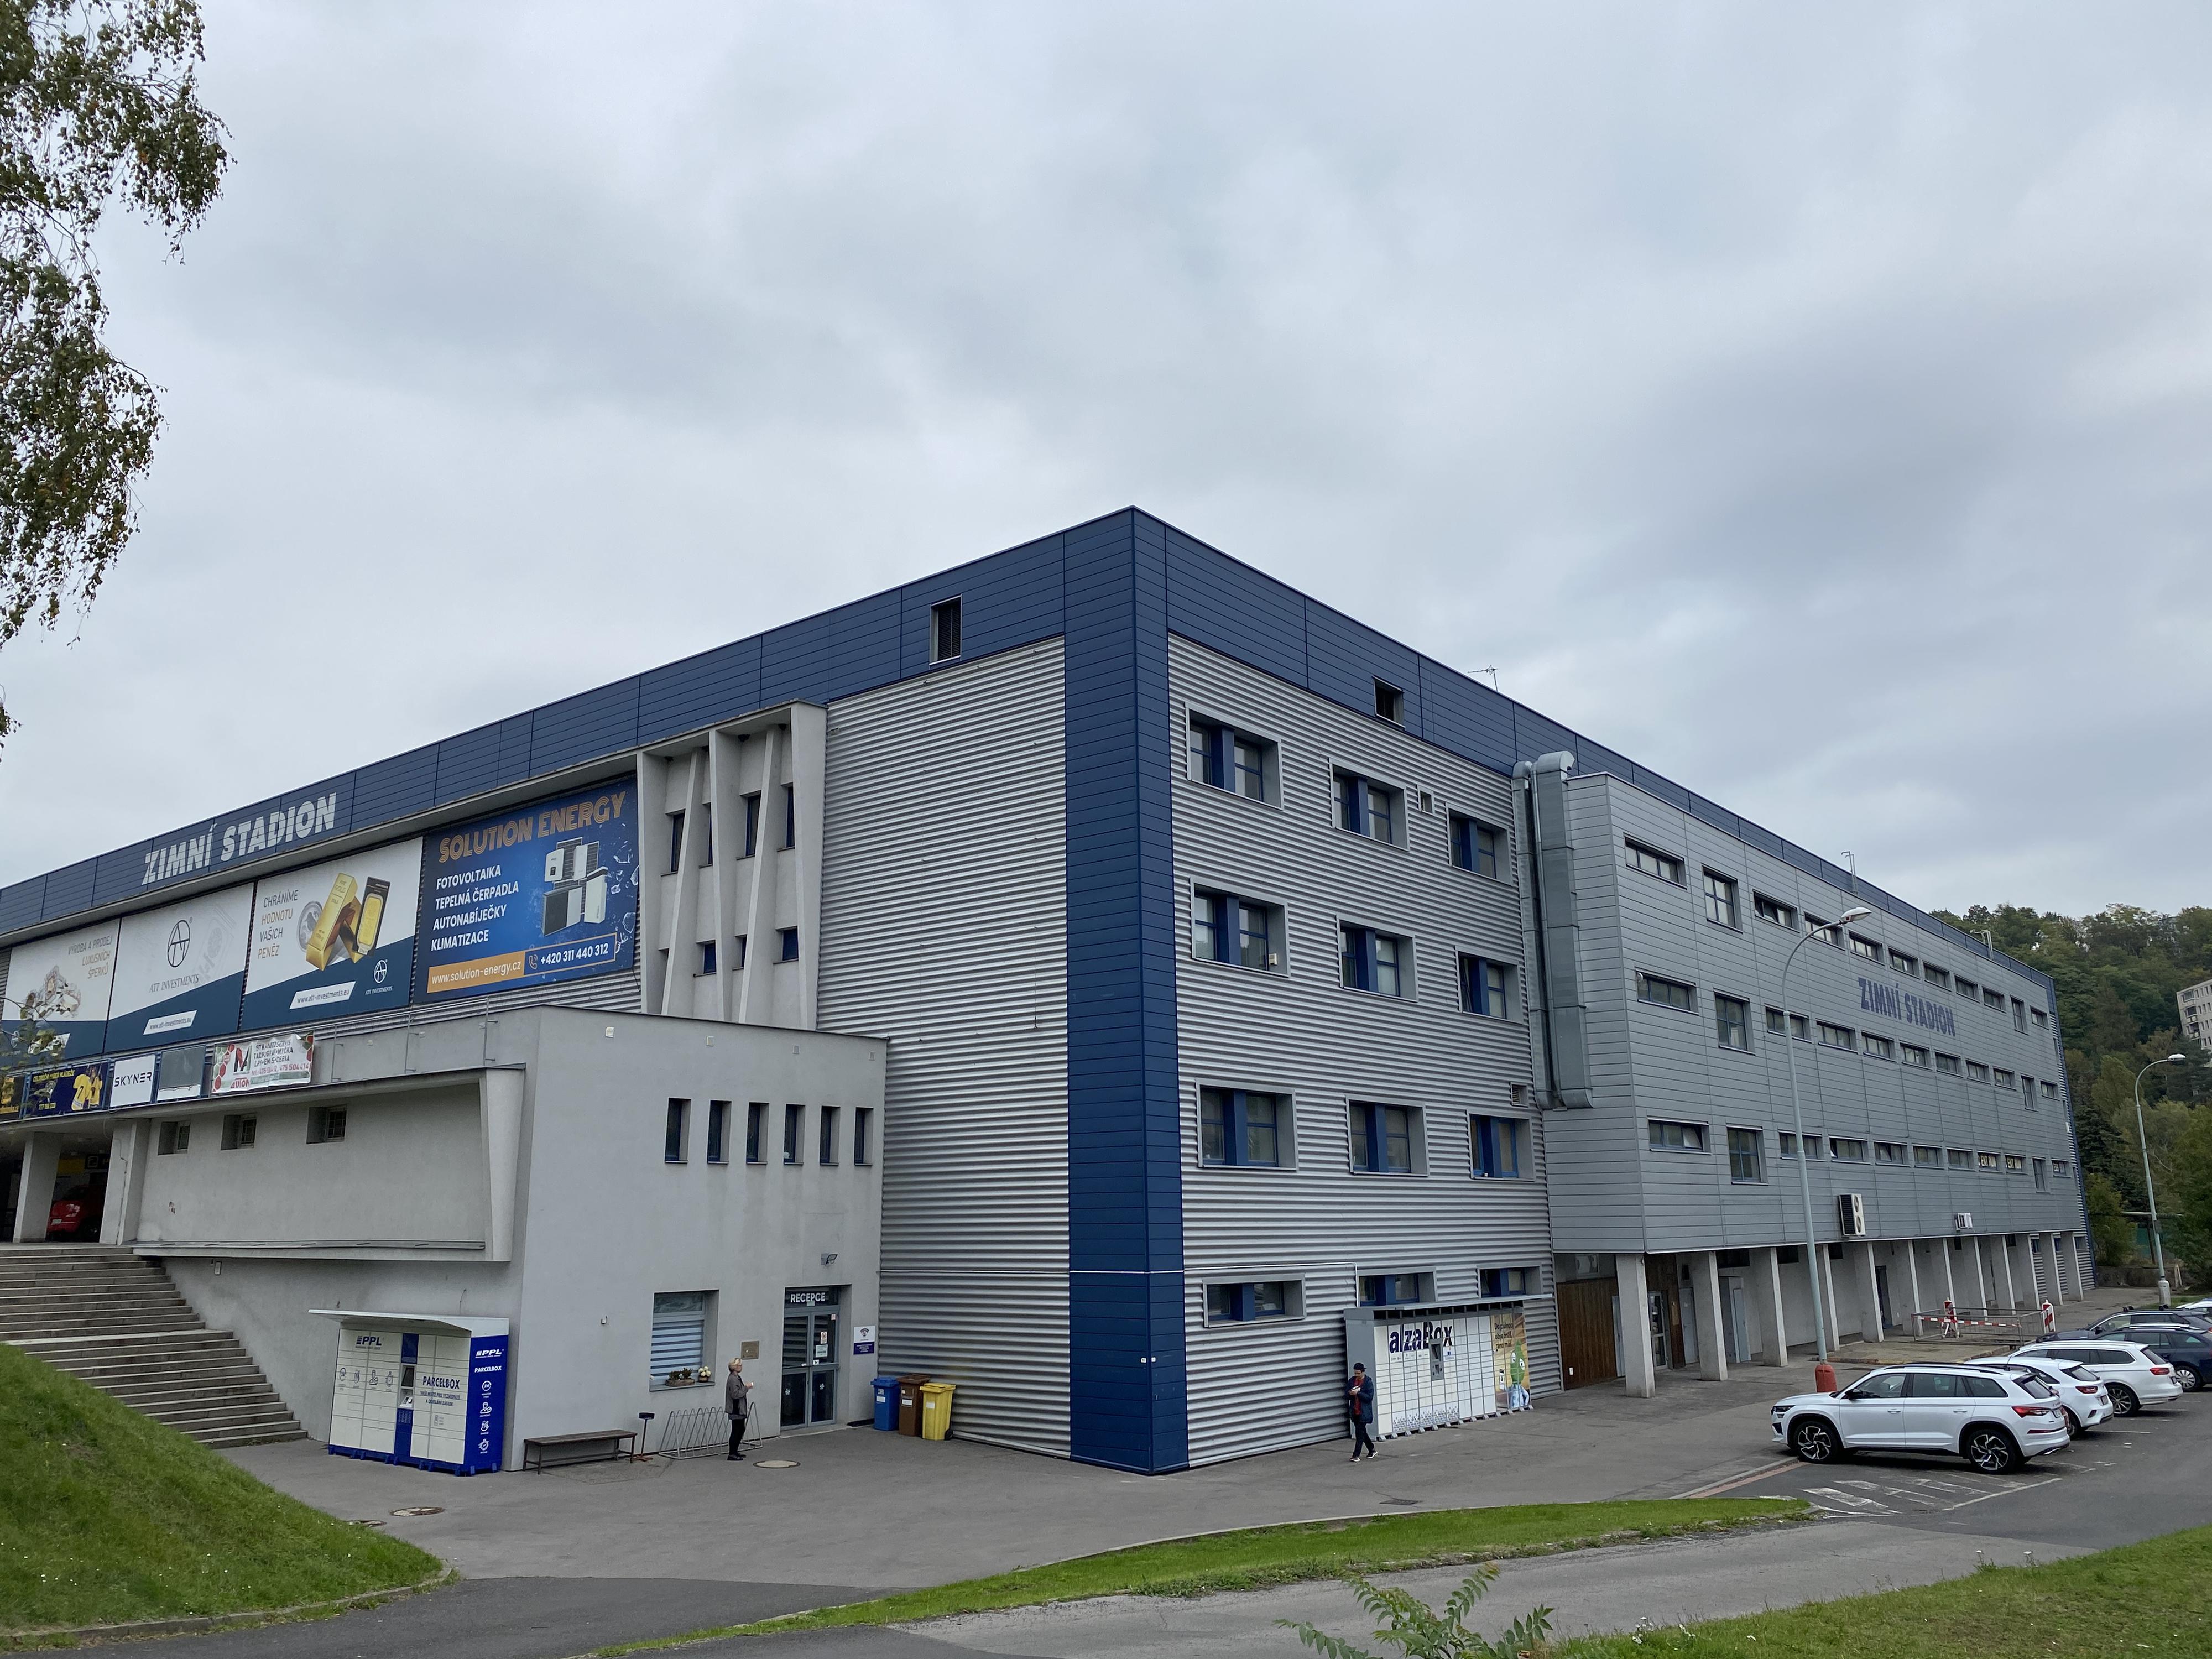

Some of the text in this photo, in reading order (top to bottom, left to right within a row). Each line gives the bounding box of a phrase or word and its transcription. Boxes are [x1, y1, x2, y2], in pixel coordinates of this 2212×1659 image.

[439, 791, 627, 863] SOLUTION ENERGY
[142, 792, 337, 885] ZIMNÍ STADION
[436, 864, 502, 890] FOTOVOLTAIKA
[263, 889, 299, 908] CHRÁNÍME
[435, 880, 519, 910] TEPELNÁ ČERPADLA
[262, 908, 293, 925] HODNOTU
[432, 904, 507, 931] AUTONABÍJEČKY
[260, 926, 283, 942] VAŠICH
[431, 930, 489, 952] KLIMATIZACE
[258, 943, 280, 959] PENĚZ
[540, 942, 609, 966] +420 311 440 312
[431, 959, 521, 984] www.solution-energy.cz
[149, 974, 200, 993] ATT INVESTMENTS
[297, 988, 349, 1004] www.att-investments.eu
[1858, 977, 1955, 1037] ZIMNÍ STADION
[114, 1072, 152, 1087] SKYNER
[790, 1292, 826, 1303] RECEPCE
[361, 1336, 382, 1346] PPL
[1389, 1321, 1453, 1354] alzaBox
[422, 1376, 460, 1390] PARCELBOX
